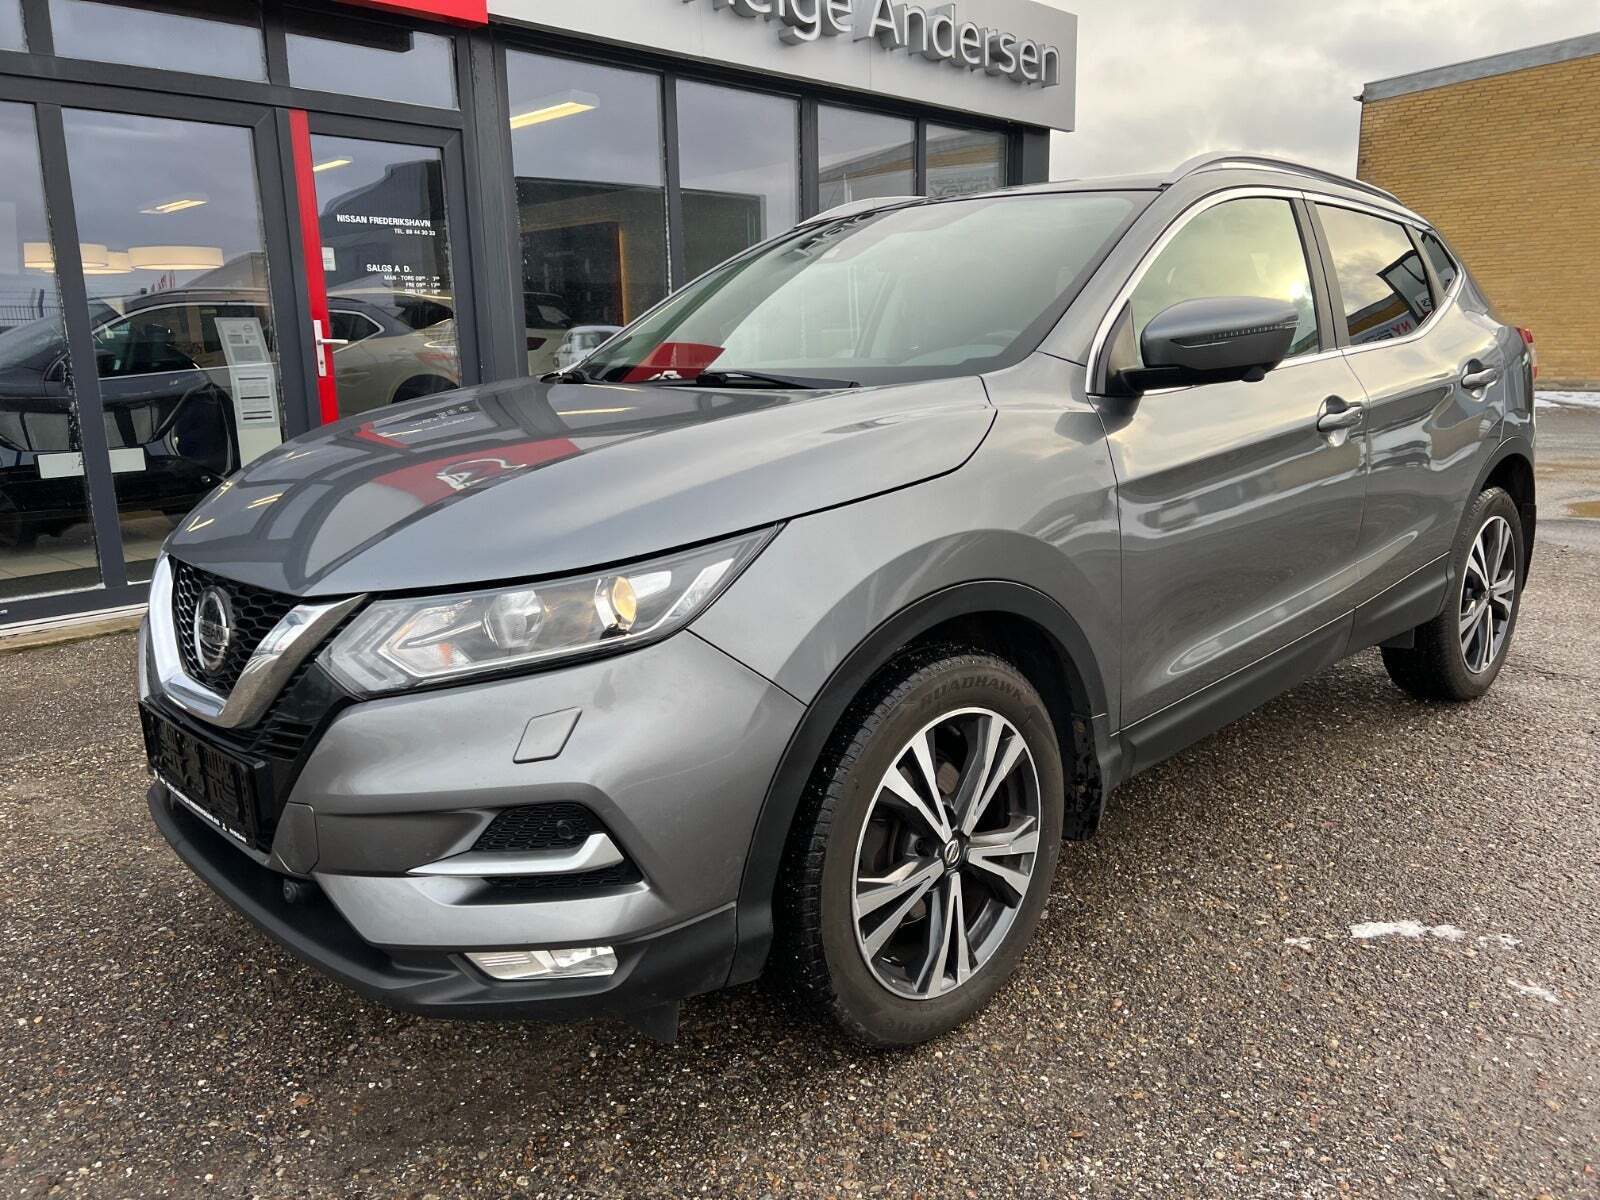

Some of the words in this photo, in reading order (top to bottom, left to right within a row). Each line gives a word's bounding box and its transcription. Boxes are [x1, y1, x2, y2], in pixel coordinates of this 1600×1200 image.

[866, 0, 1060, 87] Andersen
[336, 214, 367, 225] NISSAN
[369, 216, 431, 228] FREDERIKSHAVN
[366, 263, 392, 273] SALGS
